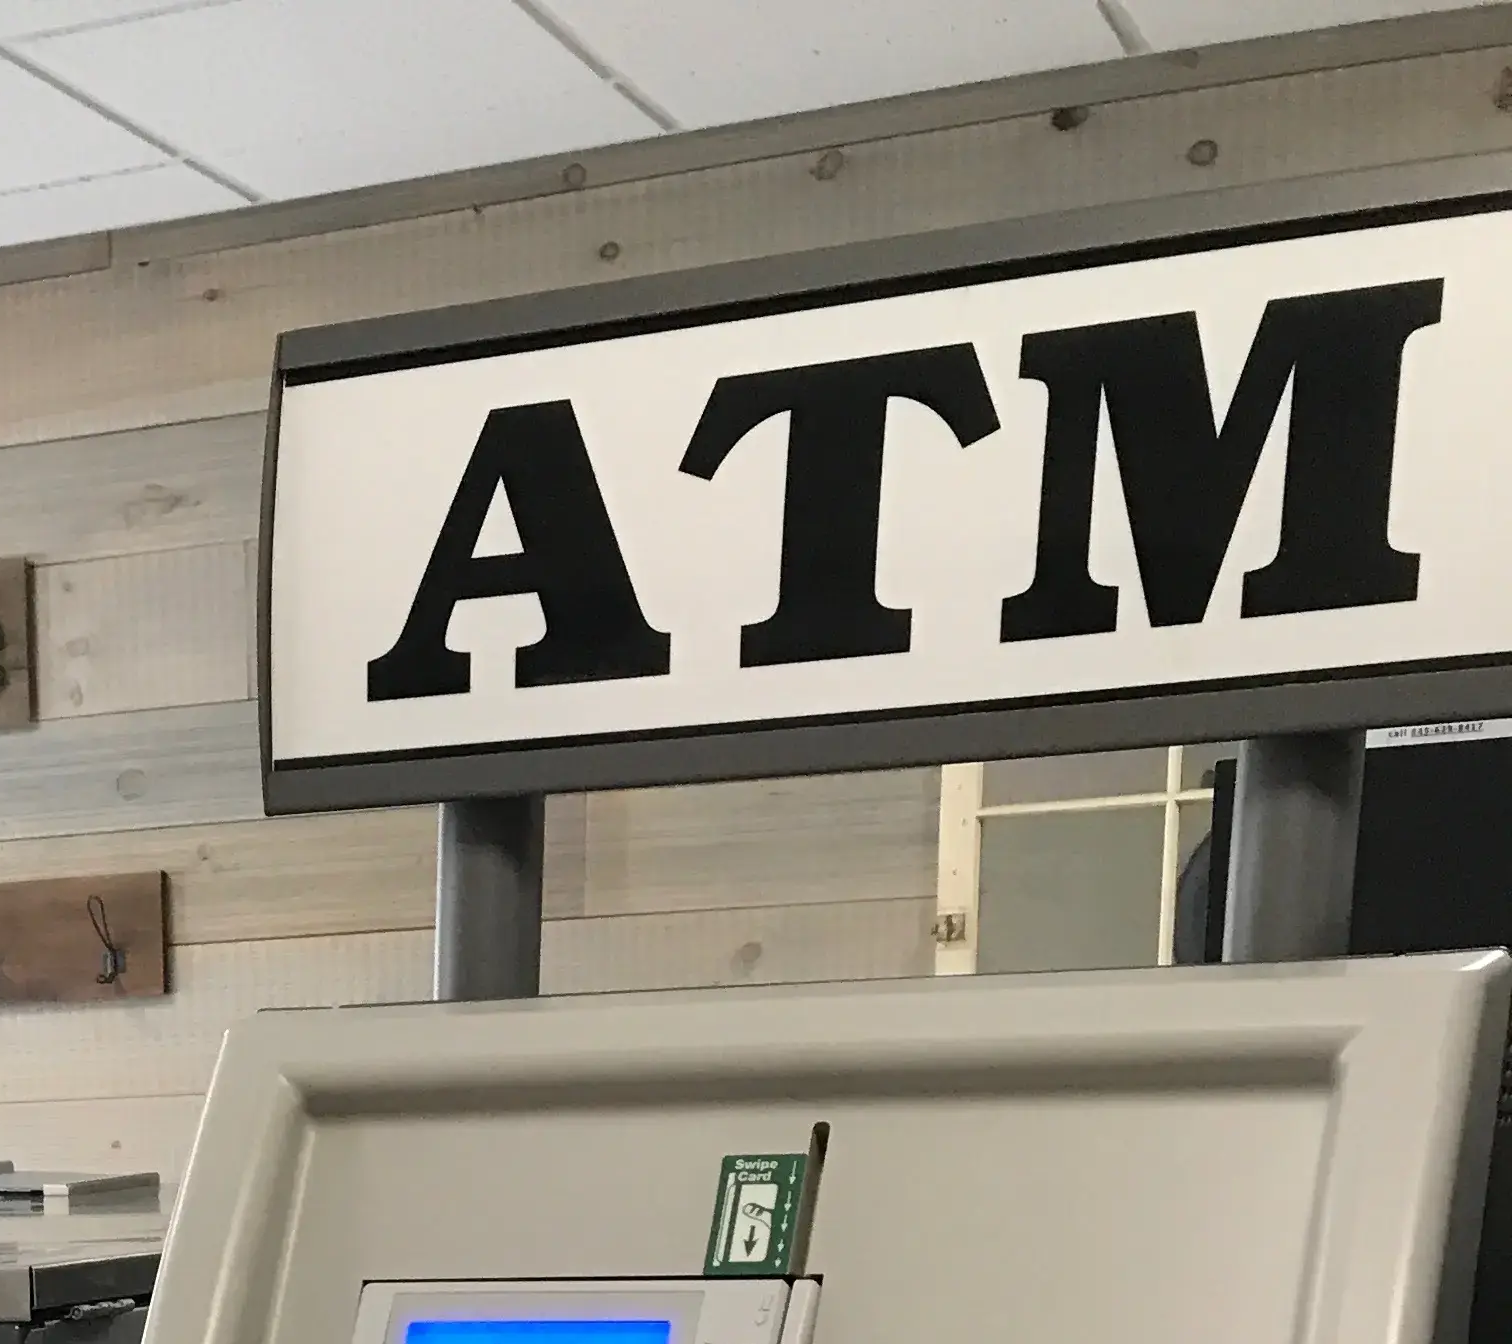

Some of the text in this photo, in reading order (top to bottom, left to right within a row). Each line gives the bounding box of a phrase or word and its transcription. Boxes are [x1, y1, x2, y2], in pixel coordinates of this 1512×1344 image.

[366, 277, 1445, 702] ATM
[734, 1159, 778, 1171] Swipe
[737, 1171, 772, 1182] Card
